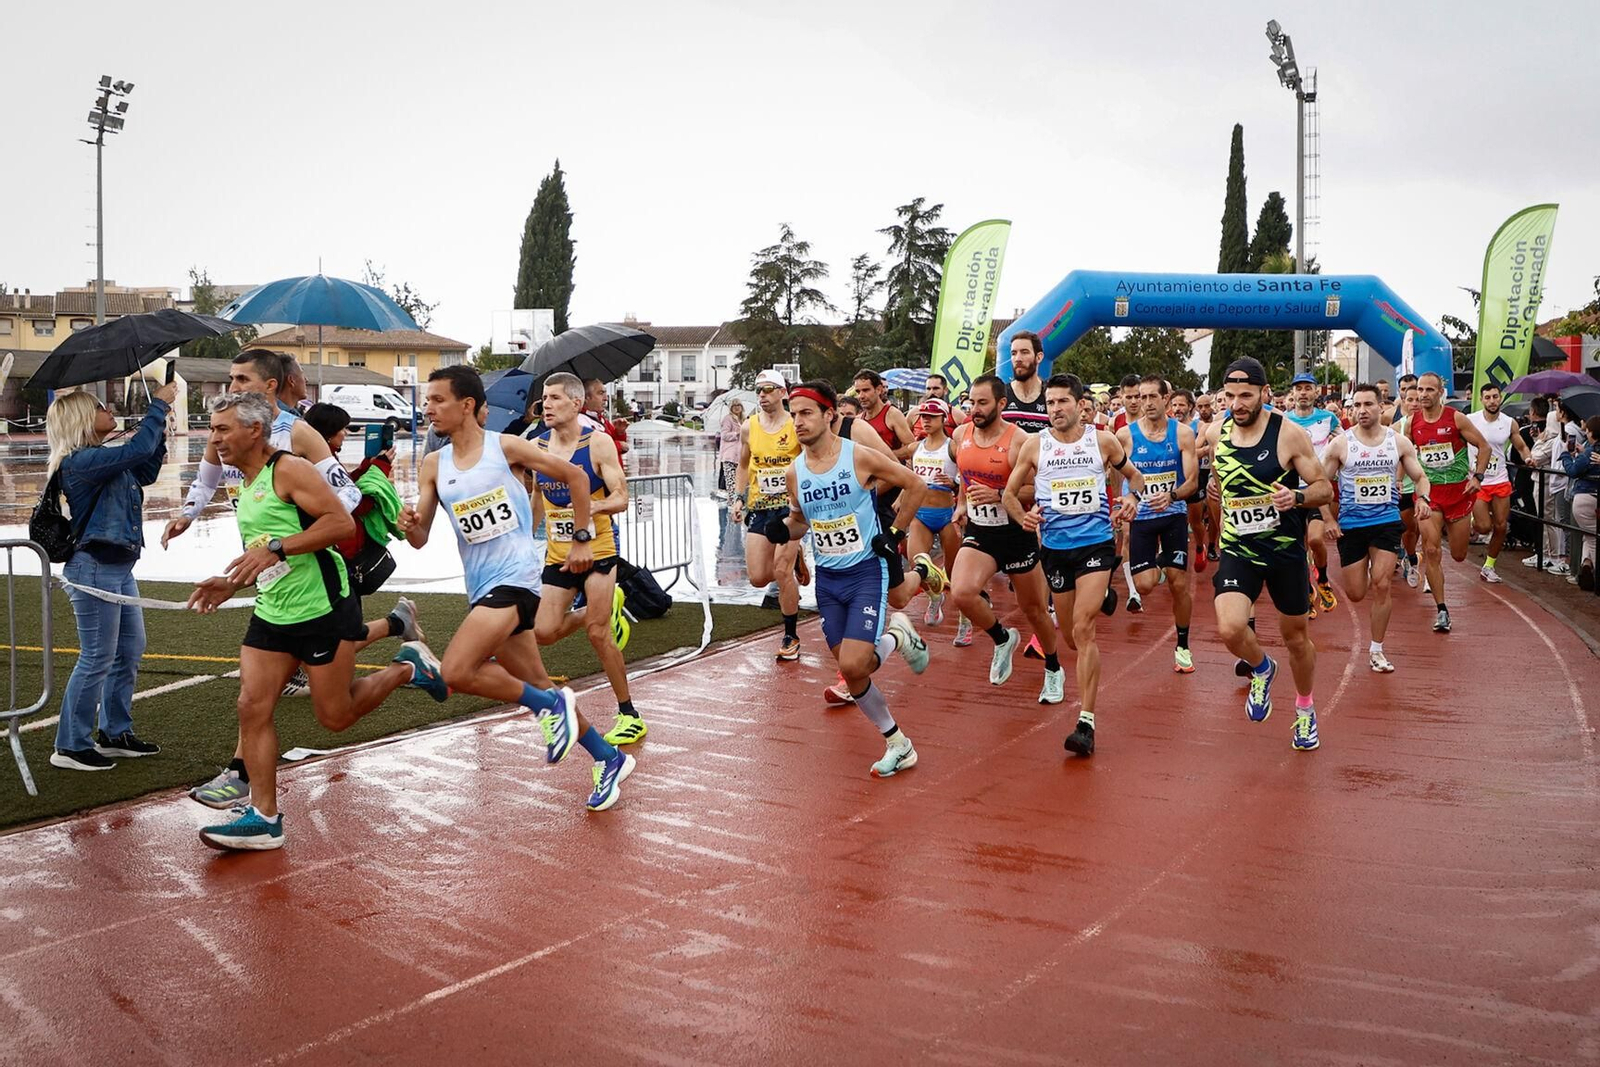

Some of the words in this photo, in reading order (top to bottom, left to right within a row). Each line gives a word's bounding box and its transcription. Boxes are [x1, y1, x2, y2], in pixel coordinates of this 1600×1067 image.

[1522, 234, 1547, 322] Granada
[976, 246, 1000, 326] Granada
[1116, 279, 1229, 294] Ayuntamiento
[1233, 280, 1251, 292] de
[1257, 279, 1313, 292] Santa
[1320, 279, 1342, 291] Fe
[956, 251, 983, 350] Diputación
[1500, 240, 1527, 350] Diputación
[1201, 303, 1215, 314] de
[1218, 303, 1270, 316] Deporte
[1274, 305, 1281, 316] y
[1285, 302, 1321, 313] Salud
[972, 330, 985, 353] de
[1047, 457, 1094, 467] MARACENA
[1425, 451, 1450, 462] 233
[763, 476, 786, 488] 153
[1144, 481, 1176, 495] 1037
[803, 481, 851, 504] nerja
[1059, 490, 1093, 506] 575
[1360, 485, 1387, 497] 923
[812, 501, 847, 513] ATLETISMO
[972, 505, 998, 518] 111
[459, 503, 512, 533] 3013
[1231, 505, 1278, 525] 1054
[815, 528, 859, 547] 3133
[1005, 559, 1034, 570] LOBATO
